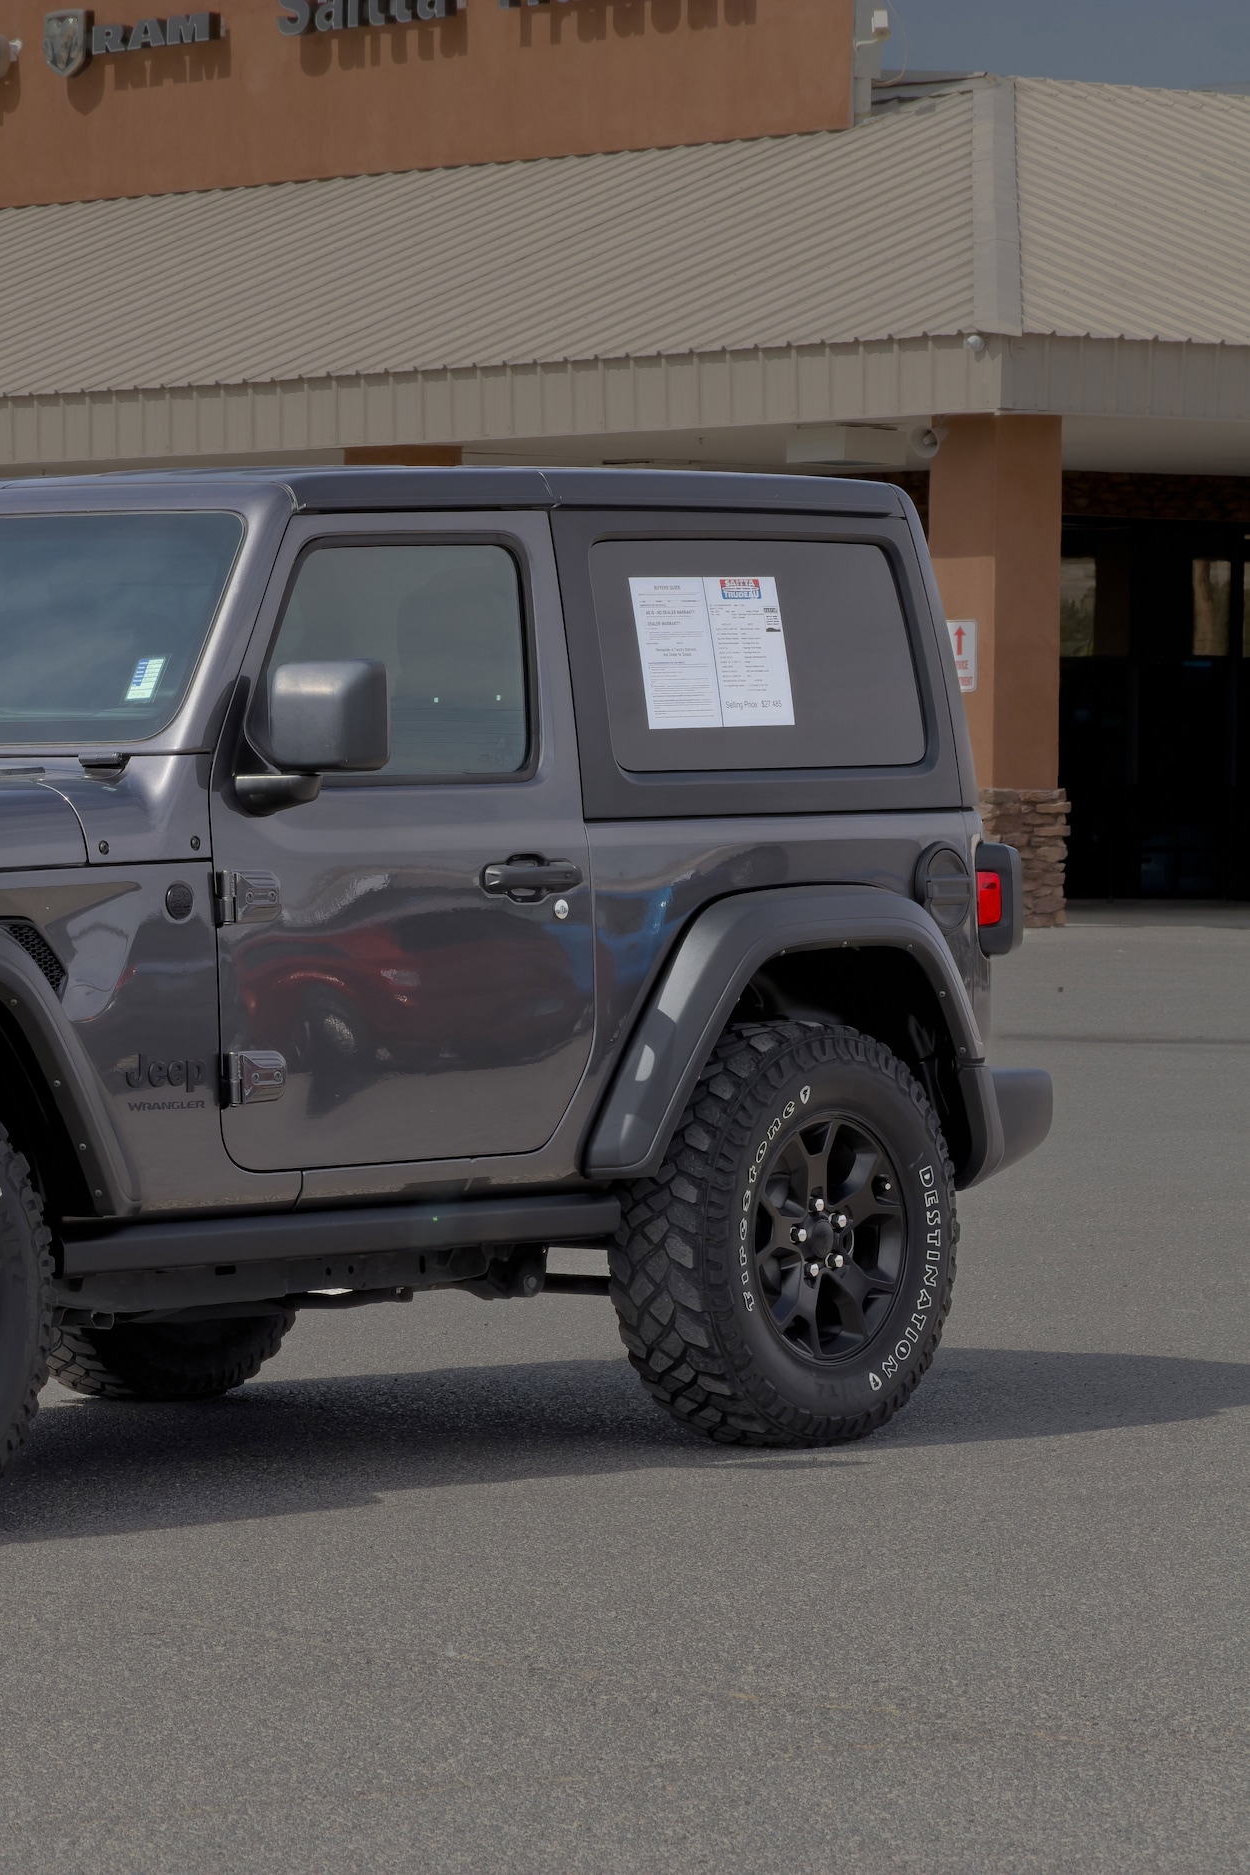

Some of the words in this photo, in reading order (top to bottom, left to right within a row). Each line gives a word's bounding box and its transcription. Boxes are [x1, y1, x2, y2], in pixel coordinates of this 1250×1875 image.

[91, 11, 210, 55] RAM
[724, 579, 756, 588] SAITTA
[724, 590, 760, 599] TRUDEAU
[725, 700, 743, 710] Selling
[125, 1053, 207, 1093] Jeep
[128, 1100, 206, 1112] WRANGLER
[881, 1165, 941, 1380] DESTINATION
